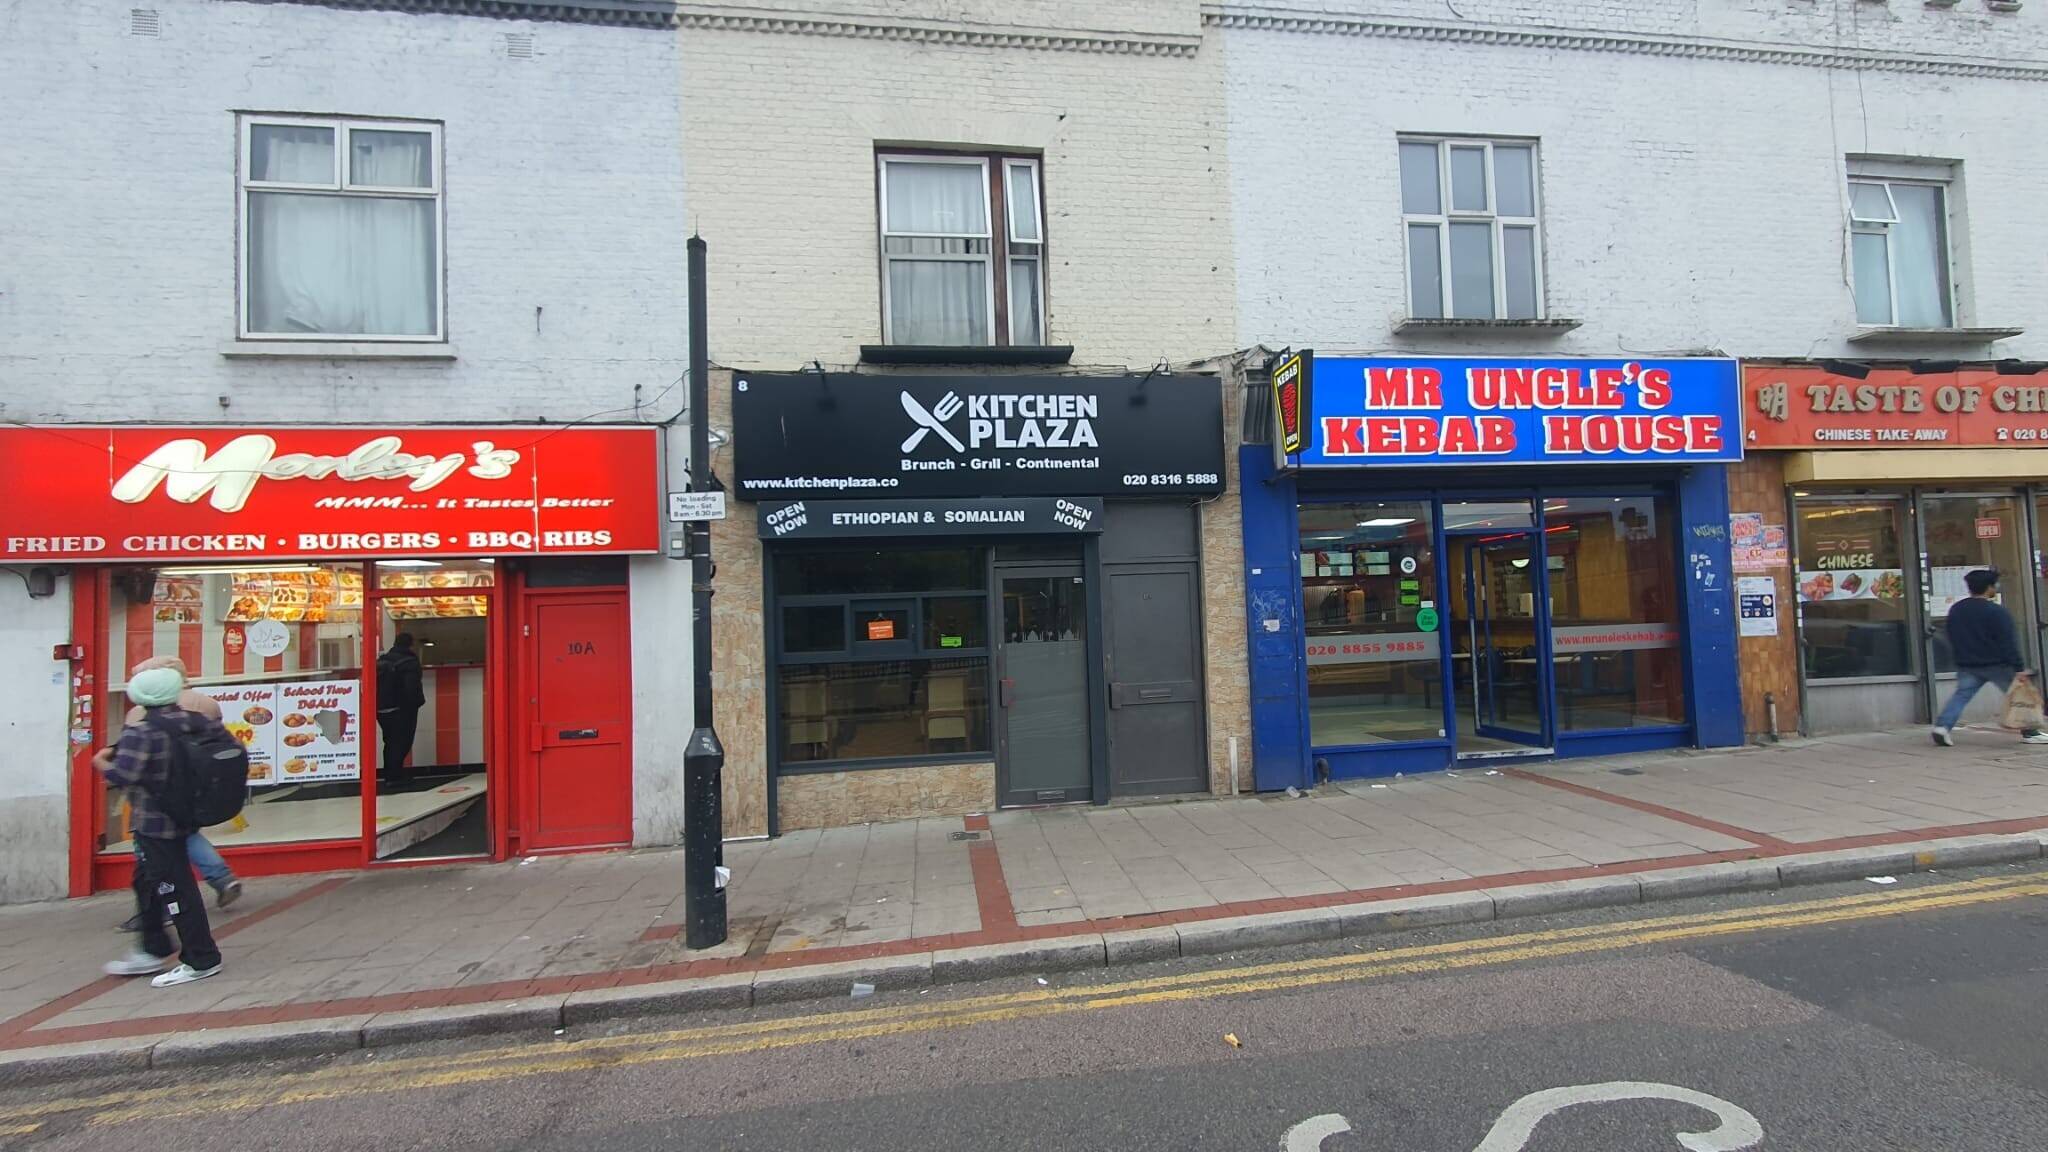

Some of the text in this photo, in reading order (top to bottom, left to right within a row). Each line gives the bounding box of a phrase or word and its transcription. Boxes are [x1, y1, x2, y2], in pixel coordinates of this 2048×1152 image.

[1277, 363, 1298, 388] KEBAB
[738, 380, 748, 392] 8
[1364, 361, 1672, 411] MR UNCLE'S
[968, 394, 1098, 419] KITCHEN
[1806, 385, 1924, 414] TASTE
[1934, 385, 1983, 414] OF
[969, 418, 1099, 449] PLAZA
[1320, 414, 1724, 457] KEBAB HOUSE
[1747, 430, 1756, 440] 4
[1814, 428, 1948, 441] CHINESE TAKE-AWAY
[2013, 428, 2037, 440] 020
[901, 458, 955, 471] Brunch
[970, 457, 1001, 470] Grill
[1016, 456, 1099, 470] Continental
[111, 434, 520, 513] Morley's
[1123, 473, 1218, 486] 020 8316 5888
[743, 476, 899, 489] www.kitchenplaza.co
[314, 496, 614, 509] MMM... It Tastes Better
[1055, 499, 1093, 521] OPEN
[766, 501, 806, 526] OPEN
[832, 510, 1025, 525] ETHIOPIAN & SOMALIAN
[1053, 510, 1087, 531] NOW
[774, 513, 808, 536] NOW
[7, 530, 612, 553] FRIED CHICKEN BURGERS BBQ RIBS
[1817, 553, 1874, 569] CHINESE
[1307, 641, 1425, 656] 020 8855 9885
[242, 689, 273, 703] Offer
[283, 684, 353, 697] School Time
[297, 698, 338, 710] DEALS
